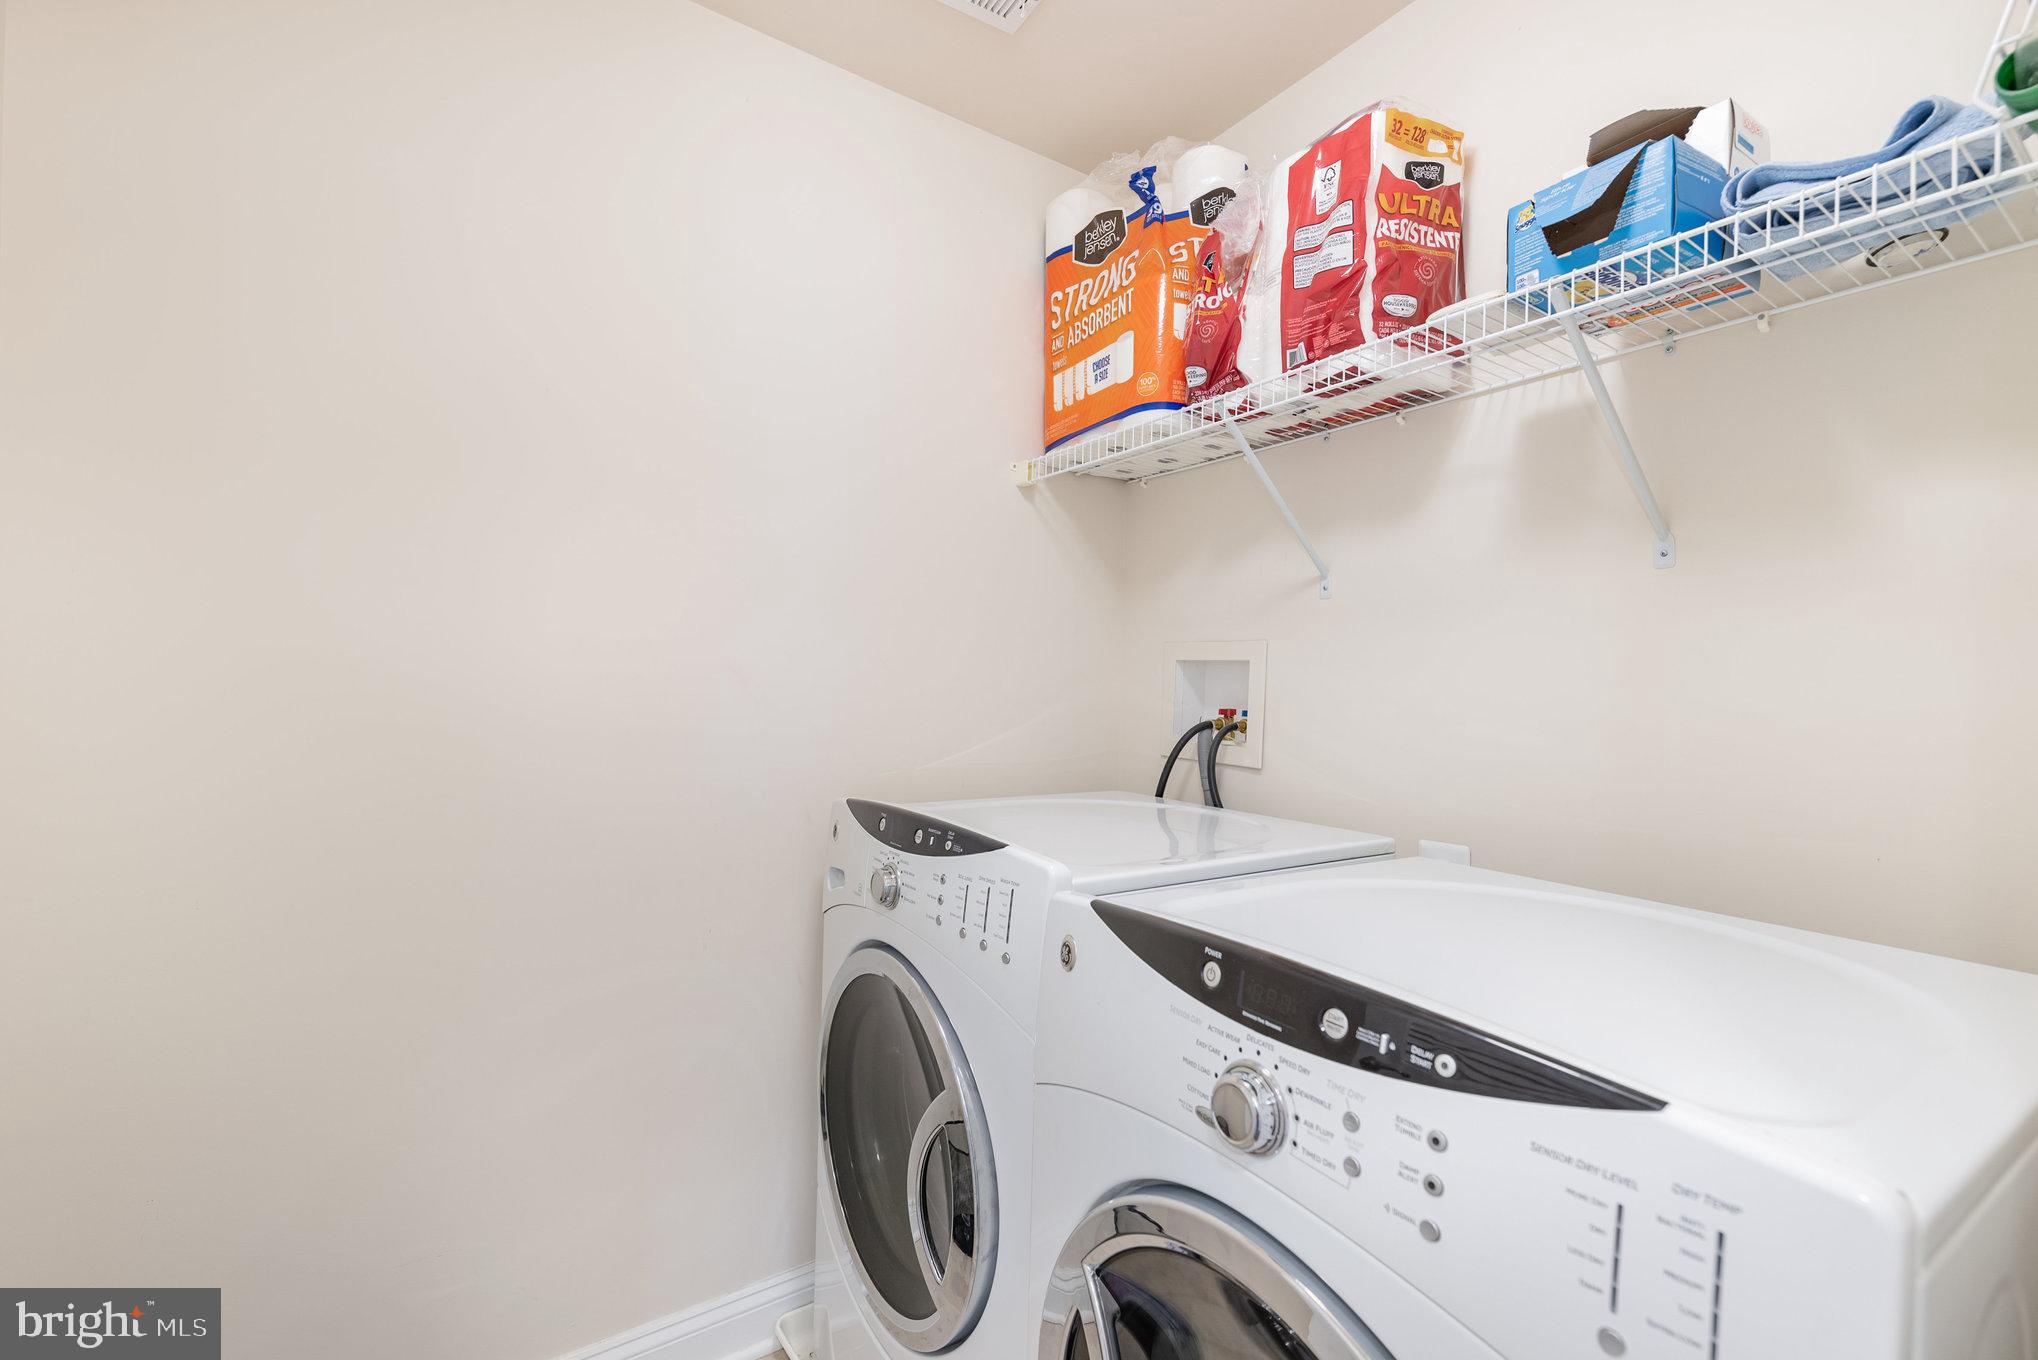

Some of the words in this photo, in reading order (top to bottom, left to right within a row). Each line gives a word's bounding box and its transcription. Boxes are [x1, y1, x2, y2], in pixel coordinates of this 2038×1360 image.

[1391, 118, 1403, 136] 32
[1411, 126, 1427, 144] 128
[1378, 191, 1461, 228] ULTRA
[1085, 216, 1117, 243] berkley
[1172, 268, 1190, 281] AND
[1050, 249, 1140, 330] STRONG
[1051, 335, 1065, 351] AND
[1067, 287, 1135, 349] ABSORBENT
[1092, 354, 1111, 373] CHOOSE
[1094, 373, 1099, 385] A
[1098, 369, 1109, 383] SIZE
[1204, 946, 1223, 960] POWER
[1207, 1024, 1225, 1038] ACTIVE
[1224, 1031, 1241, 1044] WEAR
[1246, 1033, 1275, 1052] DELICATES
[1195, 1037, 1208, 1049] EASY
[1208, 1044, 1221, 1057] CARE
[1410, 1044, 1435, 1061] DELAY
[1182, 1055, 1198, 1070] MIXED
[1197, 1065, 1211, 1078] LOAD
[1279, 1055, 1298, 1072] SPEED
[1298, 1062, 1311, 1077] DRY
[1186, 1083, 1210, 1102] COTTONS
[1303, 1119, 1315, 1131] AIR
[1315, 1124, 1335, 1140] FLUFF
[1301, 1147, 1323, 1165] TIMED
[1322, 1156, 1337, 1171] DRY
[1529, 1140, 1575, 1167] SENSOR
[1601, 1169, 1640, 1193] LEVEL
